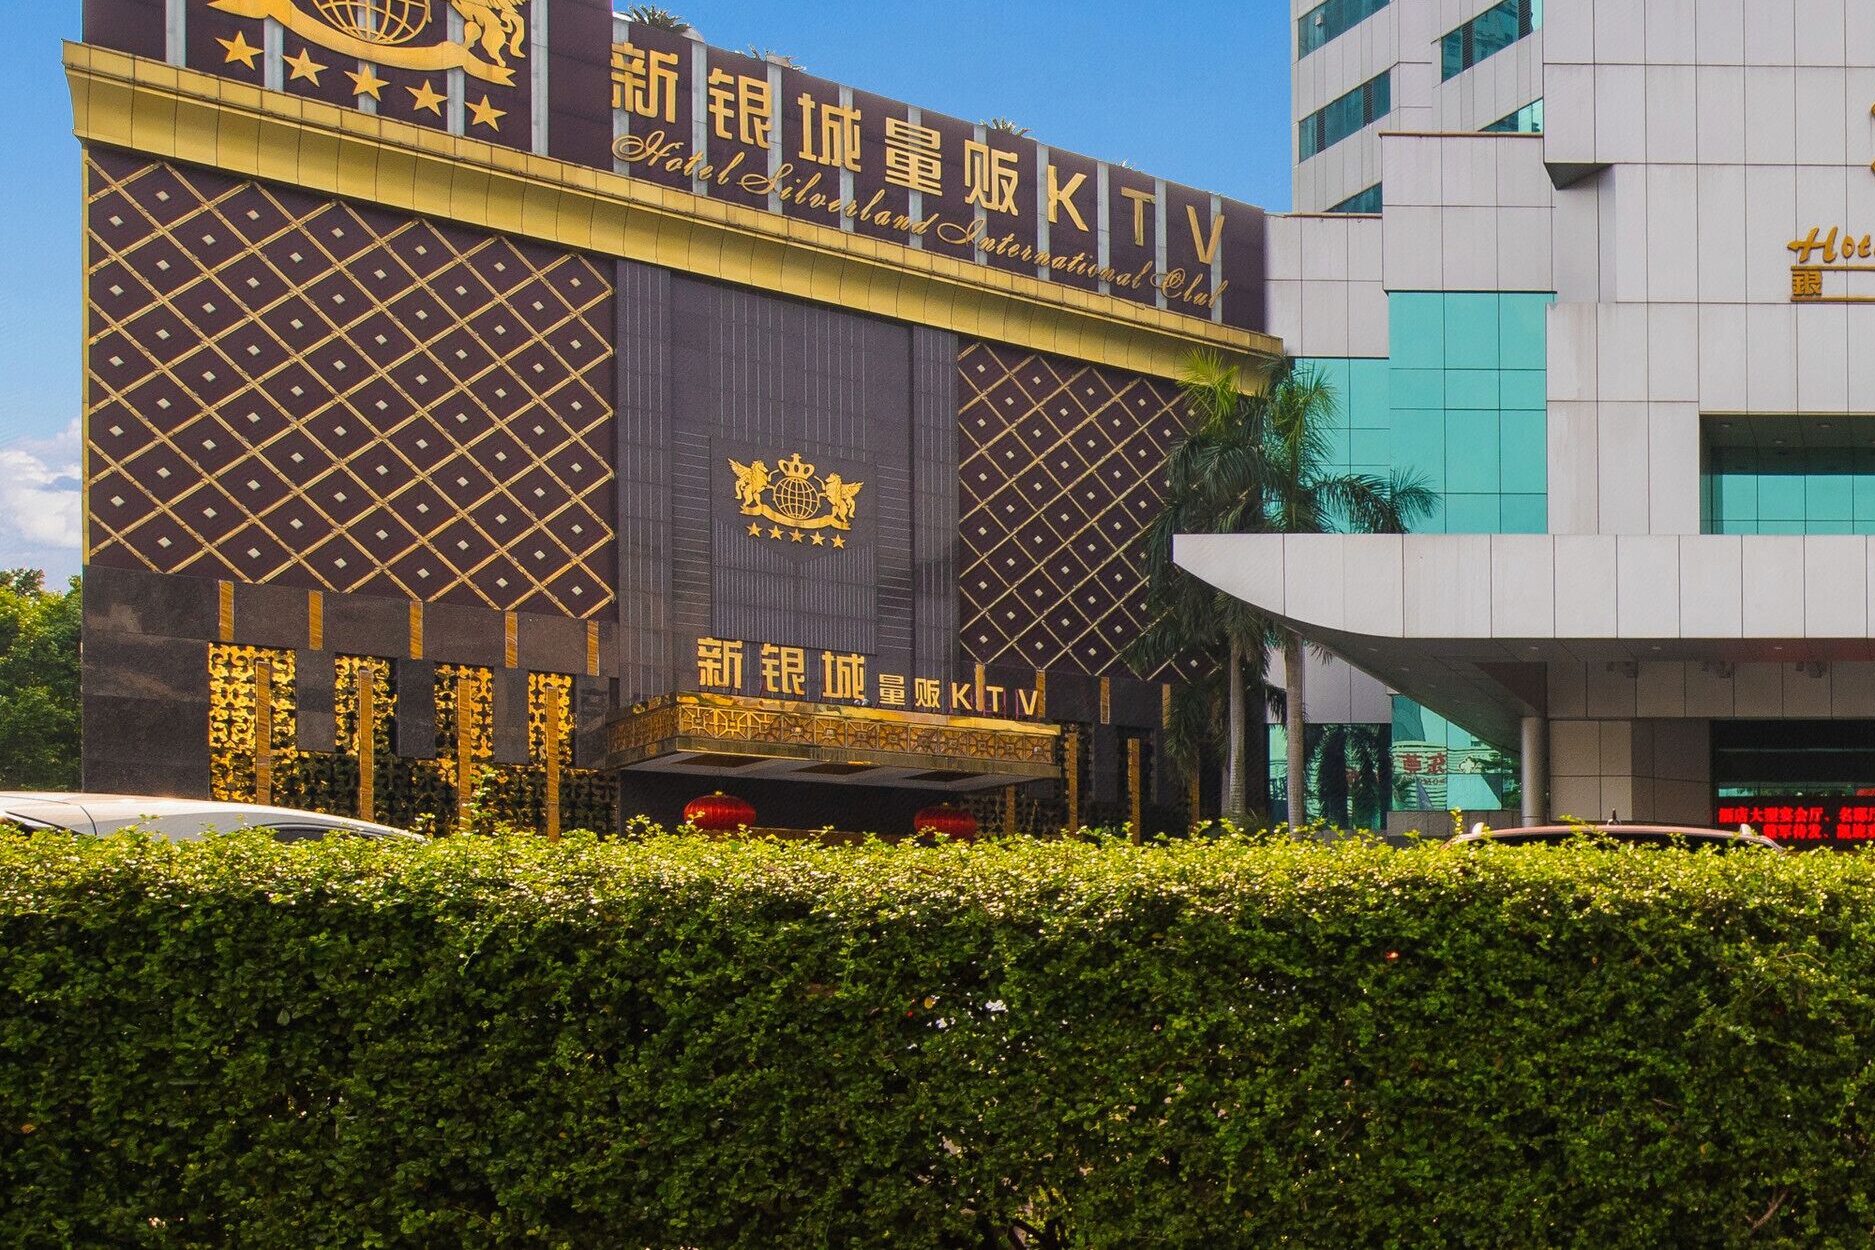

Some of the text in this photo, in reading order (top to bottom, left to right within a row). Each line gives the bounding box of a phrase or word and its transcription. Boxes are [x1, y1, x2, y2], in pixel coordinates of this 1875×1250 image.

[611, 130, 1229, 309] Hotel Silverland International Club
